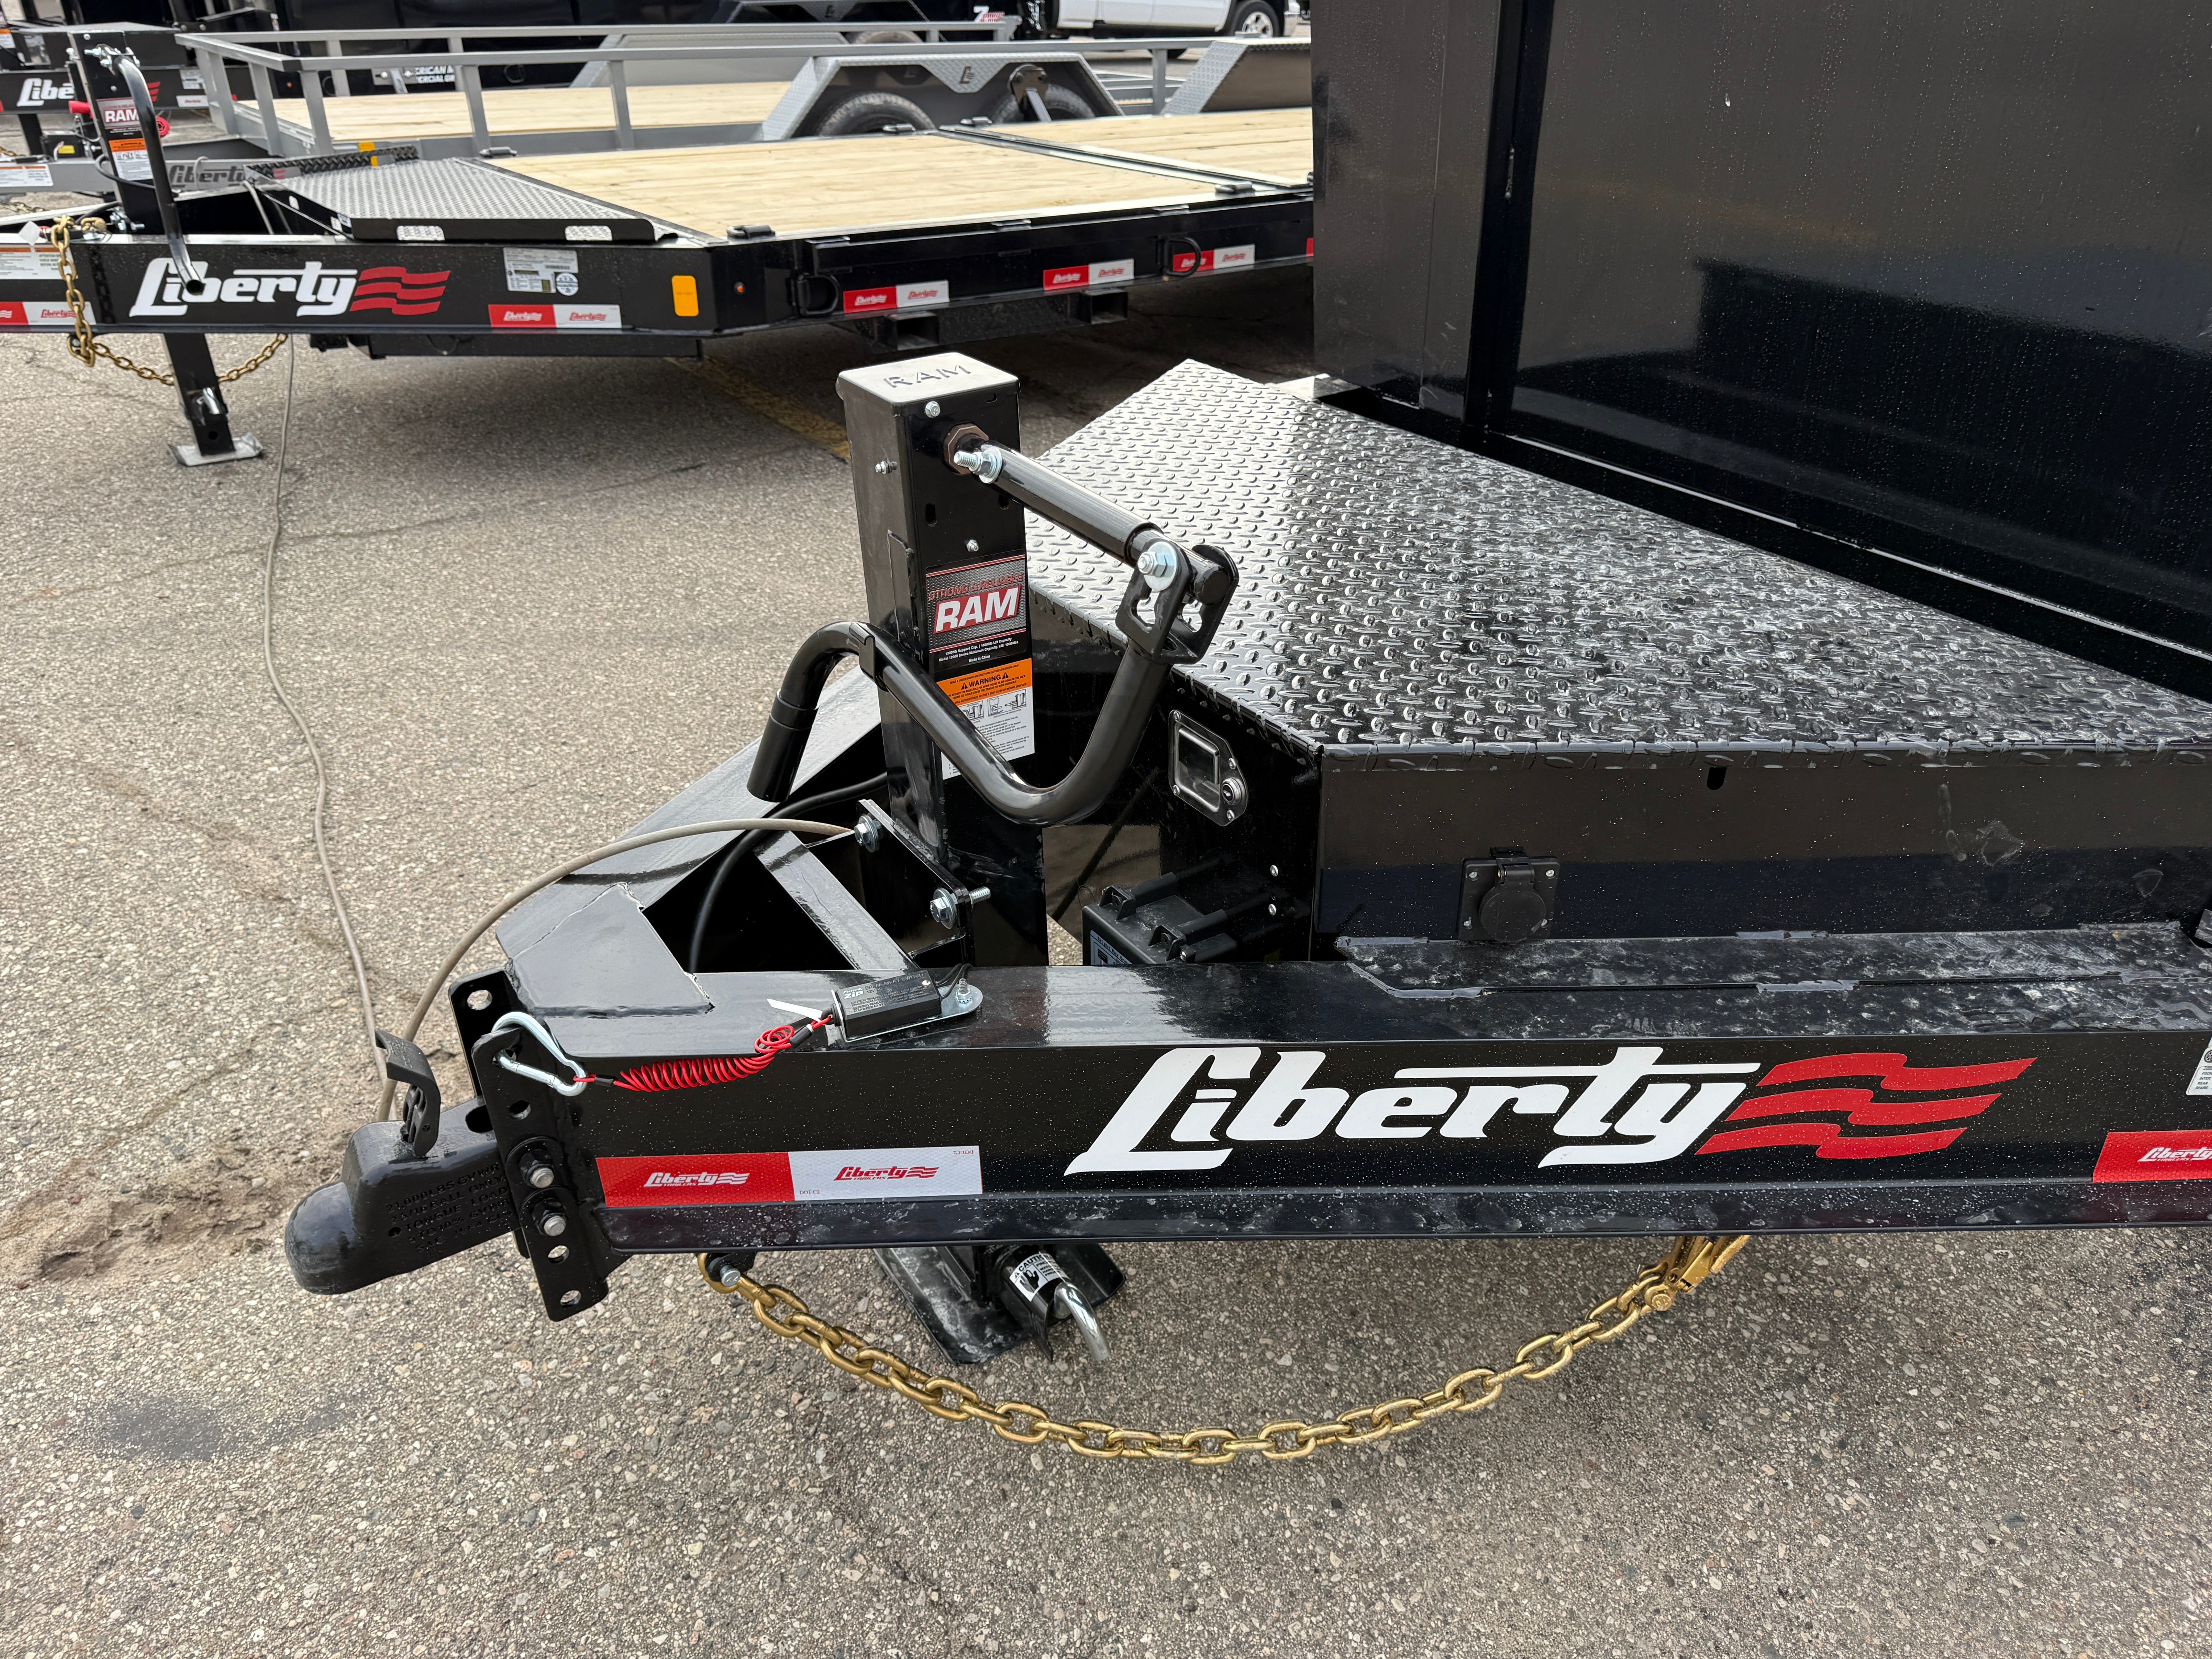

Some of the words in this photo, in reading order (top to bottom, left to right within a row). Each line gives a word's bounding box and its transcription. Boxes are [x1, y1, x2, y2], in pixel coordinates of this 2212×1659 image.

[16, 77, 75, 107] Libe
[105, 109, 139, 123] RAM
[129, 257, 358, 317] Liberty
[883, 365, 972, 388] RAM
[929, 584, 969, 601] STRONG
[979, 573, 1024, 589] RELIABLE
[935, 587, 1019, 632] RAM
[969, 674, 1001, 688] WARNING
[1063, 1046, 1760, 1176] Liberty
[2137, 1147, 2212, 1162] Liberty
[643, 1172, 719, 1187] Liberty
[833, 1166, 909, 1181] Liberty
